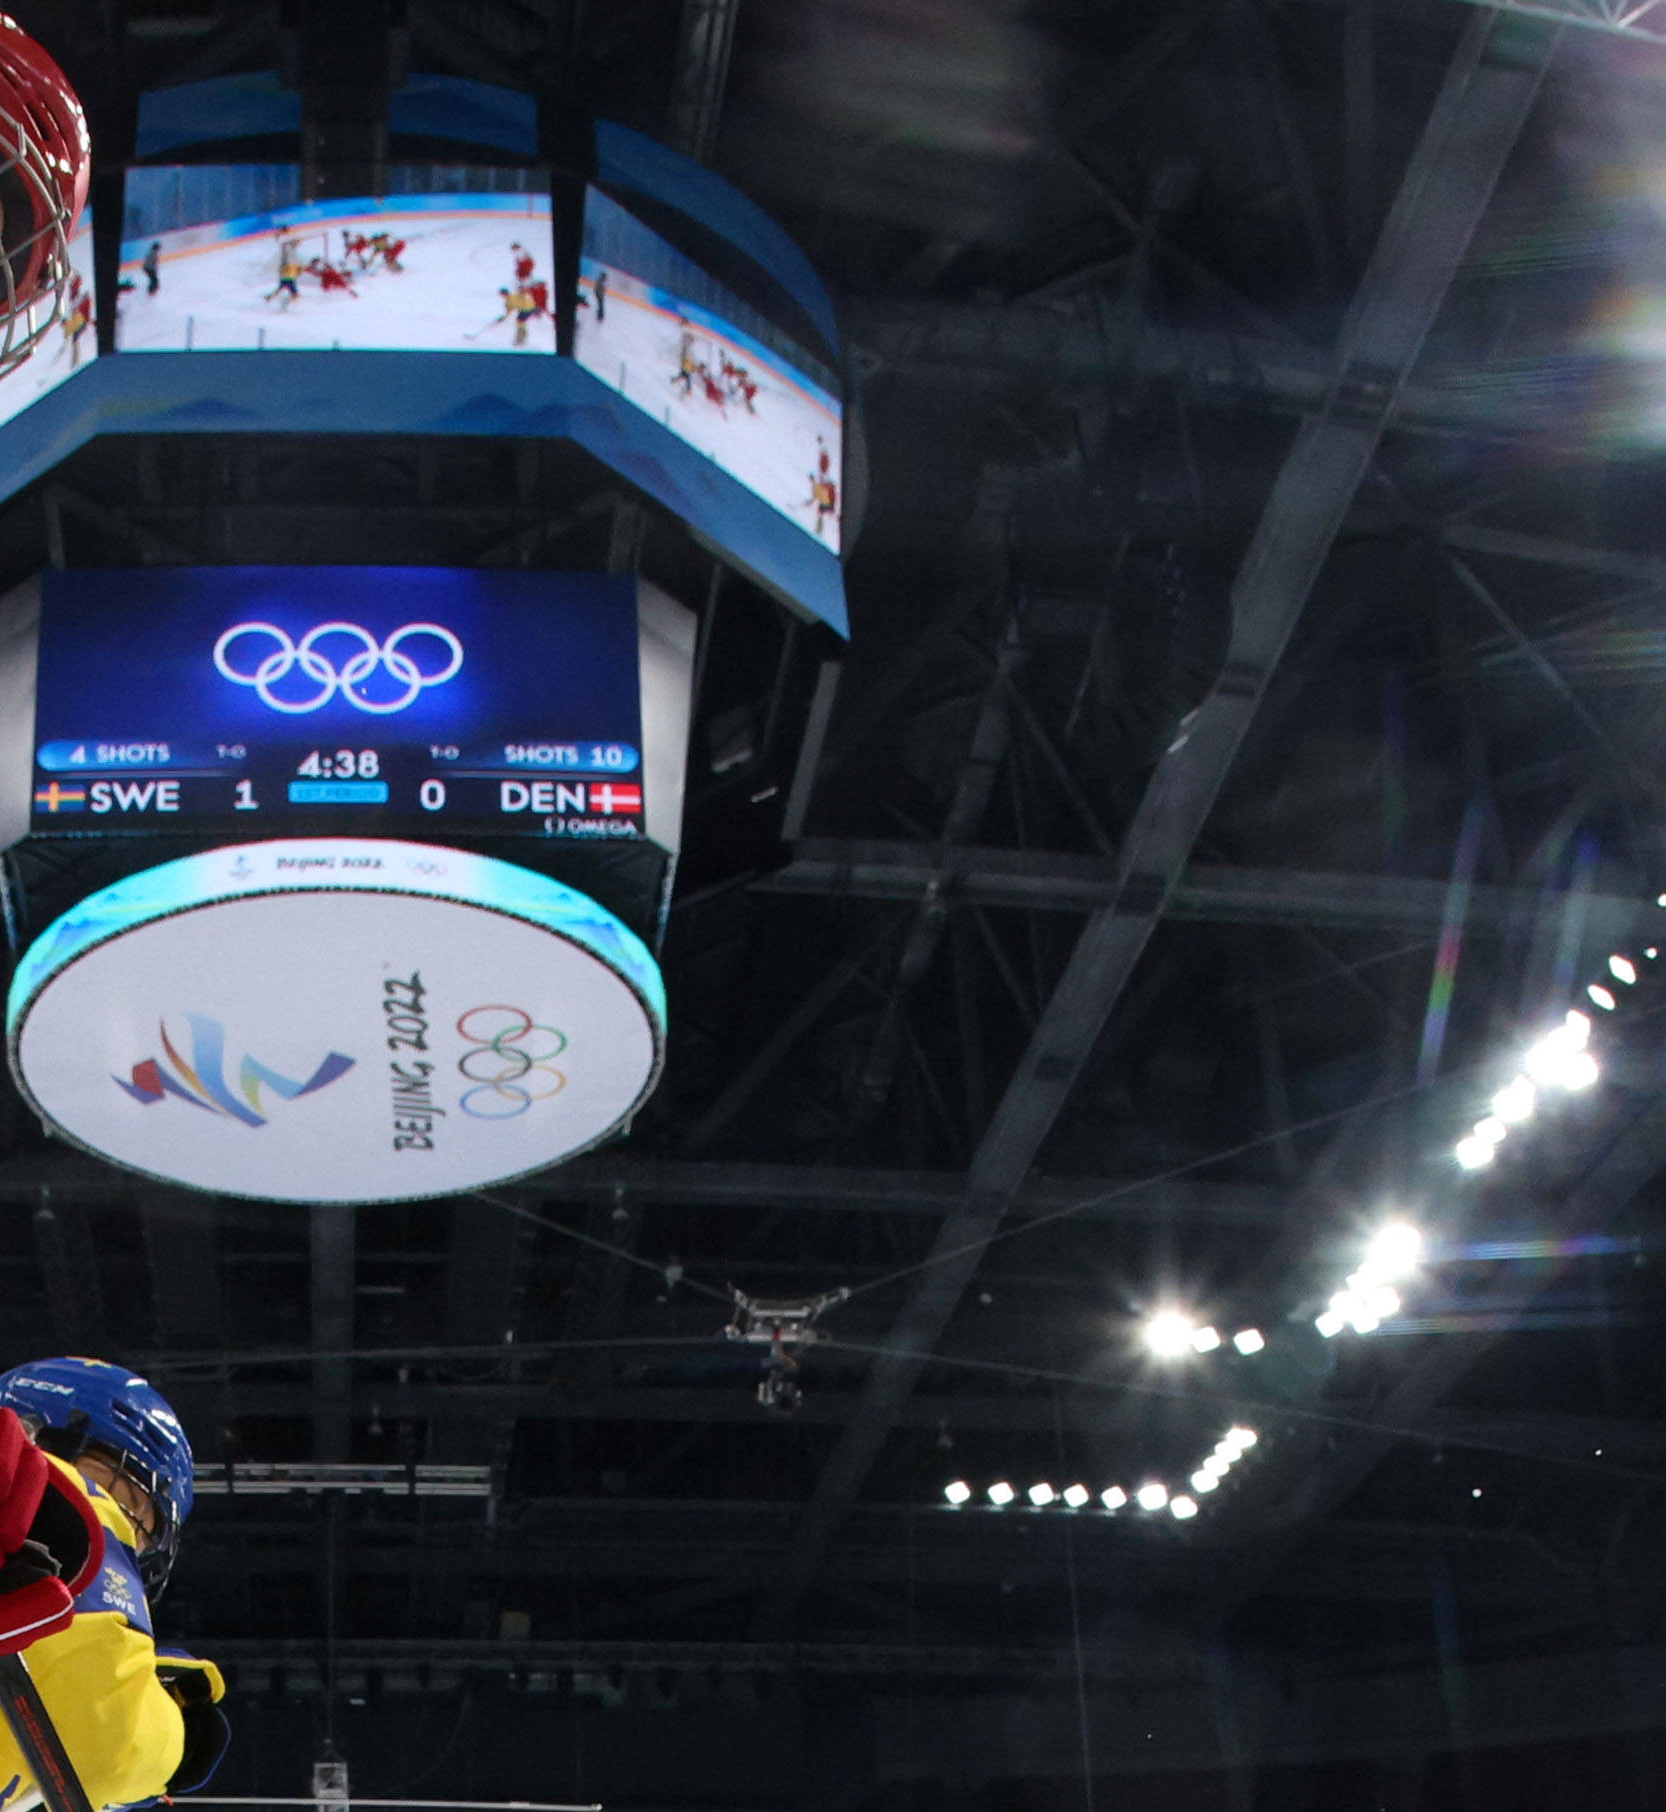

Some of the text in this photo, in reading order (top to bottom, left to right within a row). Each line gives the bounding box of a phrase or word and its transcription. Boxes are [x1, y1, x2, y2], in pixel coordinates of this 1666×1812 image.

[69, 744, 171, 764] 4 SHOTS
[297, 749, 380, 778] 4:38
[504, 744, 623, 765] SHOTS 10
[89, 779, 260, 814] SWE 1
[419, 778, 586, 813] 0 DEN
[567, 819, 638, 834] OMEGA
[383, 969, 446, 1151] BEIJING 2022
[102, 1591, 137, 1616] SWE
